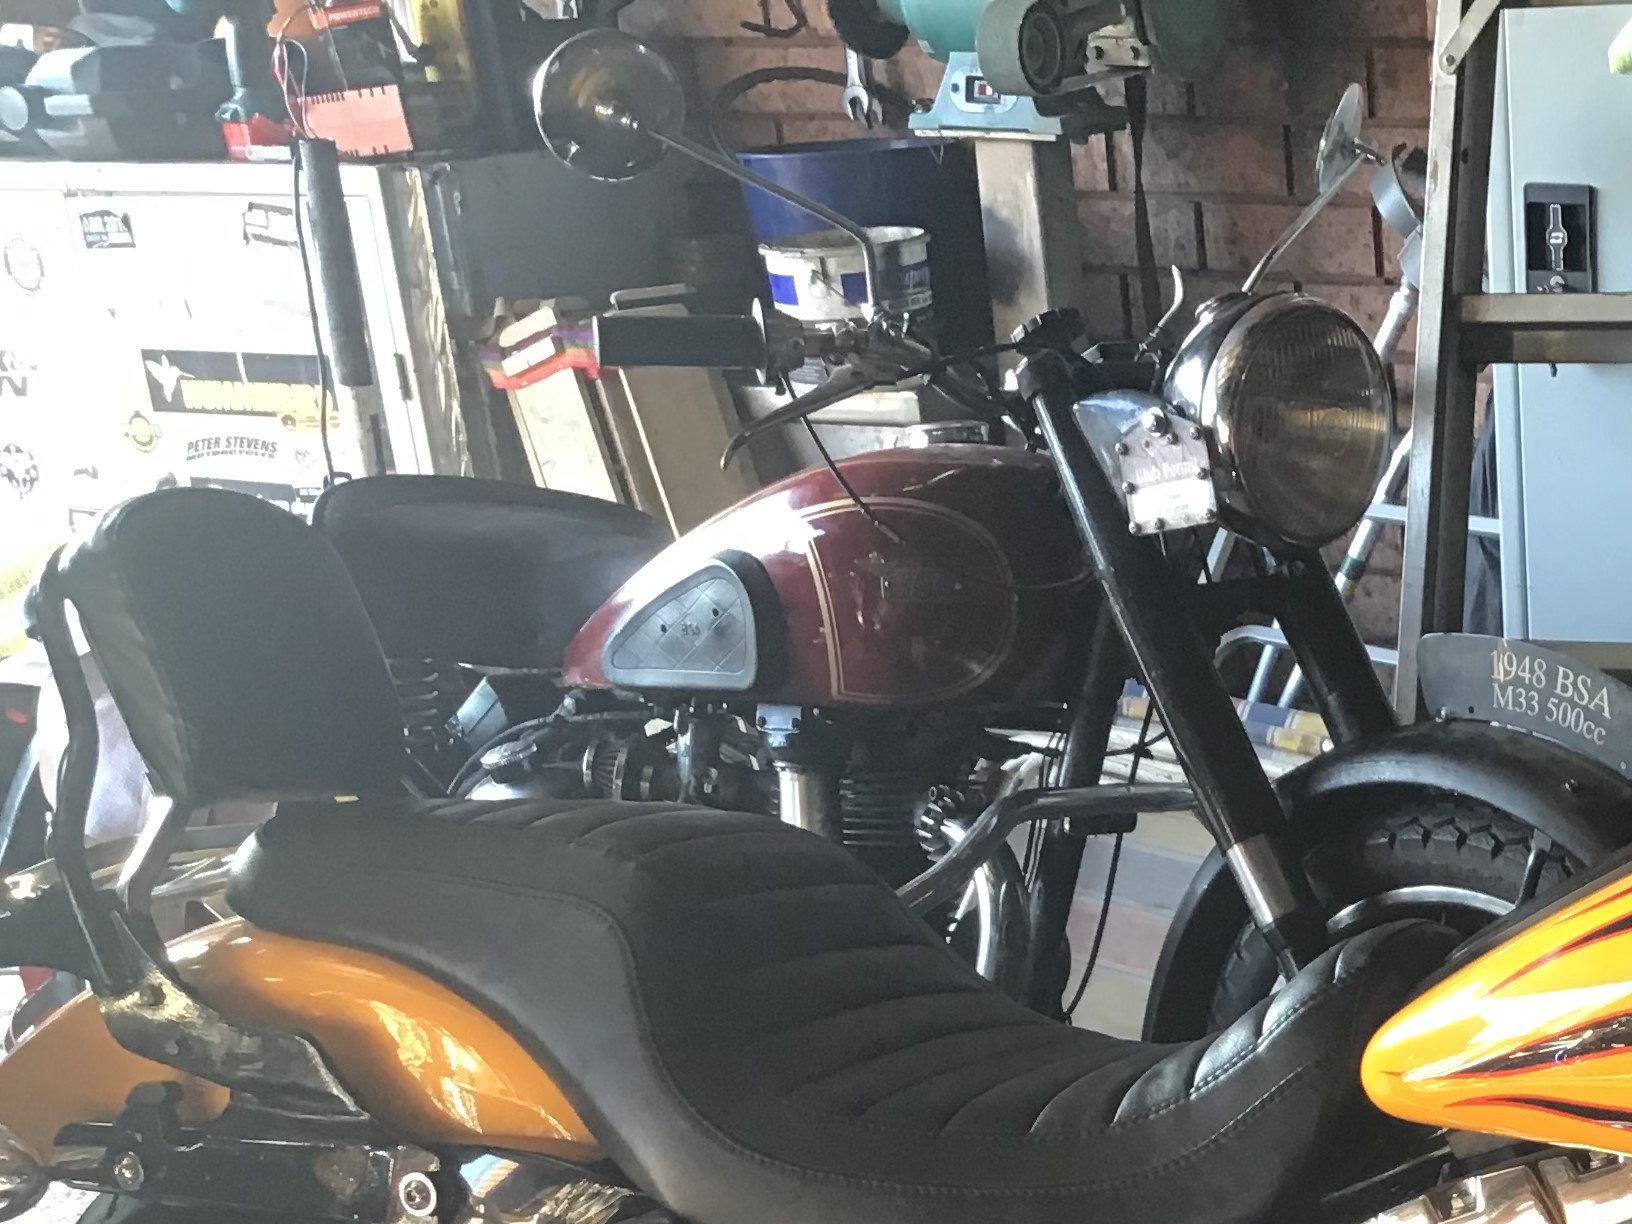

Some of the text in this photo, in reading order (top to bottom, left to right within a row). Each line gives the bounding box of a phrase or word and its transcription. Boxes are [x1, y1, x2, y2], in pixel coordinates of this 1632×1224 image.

[187, 436, 277, 454] PETER STEVENS
[1490, 650, 1612, 719] 1948 BSA
[1492, 683, 1606, 745] M33 500cc
